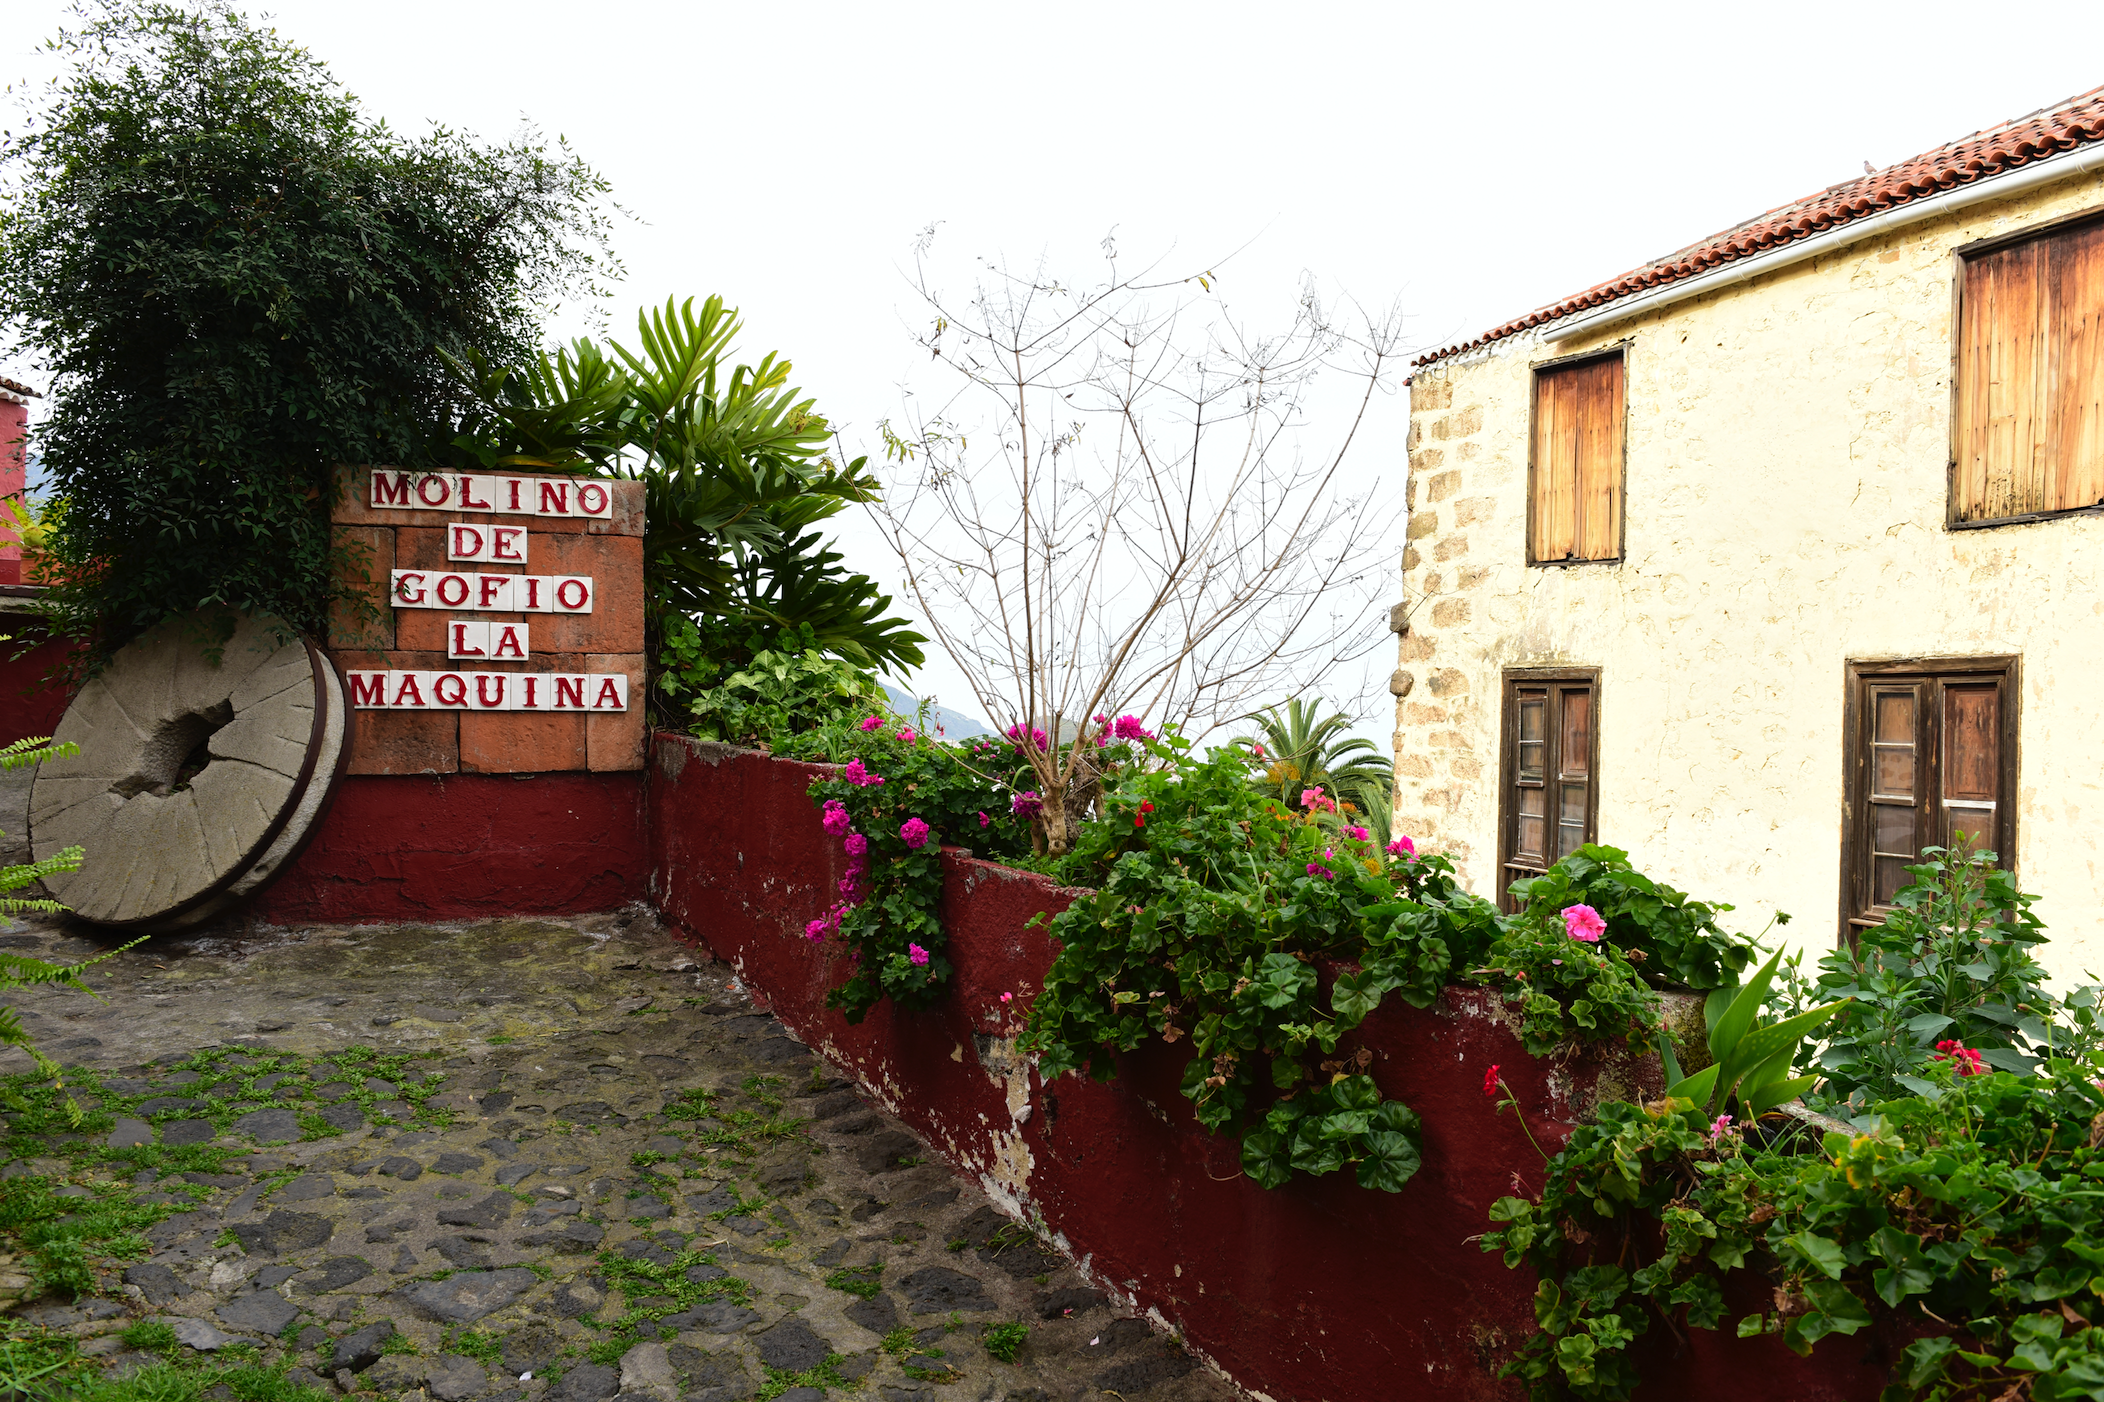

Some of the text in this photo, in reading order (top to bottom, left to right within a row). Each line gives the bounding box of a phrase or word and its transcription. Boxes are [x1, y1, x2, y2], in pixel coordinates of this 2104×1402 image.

[373, 472, 609, 515] MOLINO
[451, 526, 523, 560] DE
[396, 573, 590, 609] GOFIO
[452, 624, 525, 657] LA
[350, 673, 624, 709] MAQUINA
